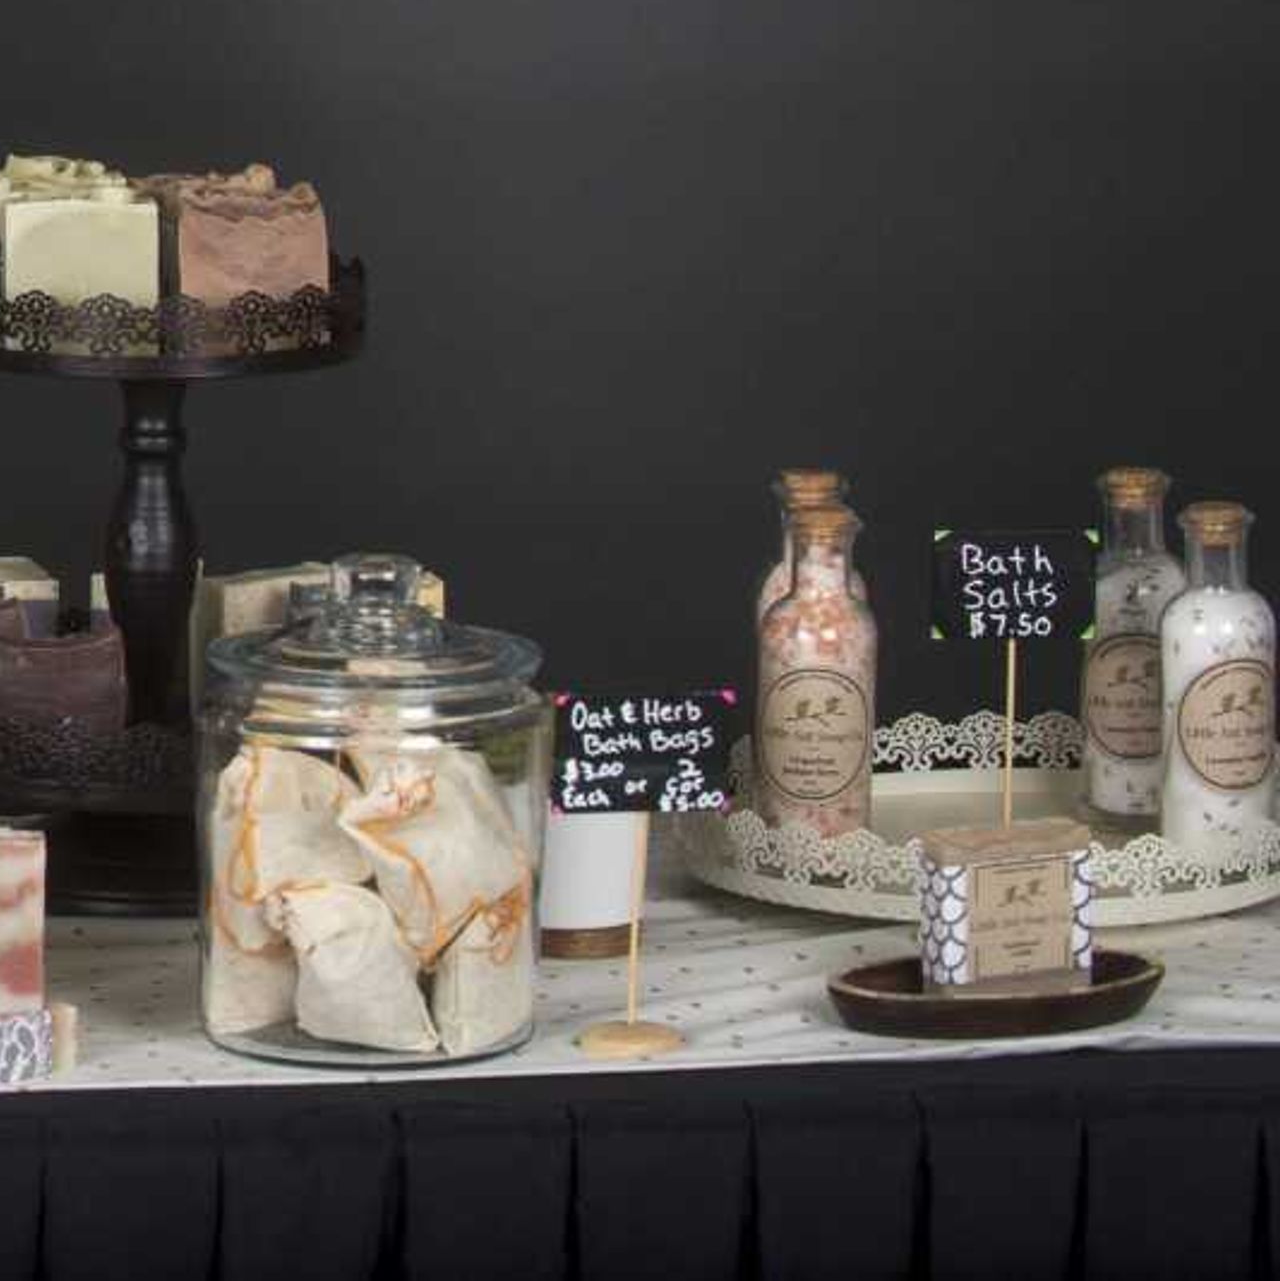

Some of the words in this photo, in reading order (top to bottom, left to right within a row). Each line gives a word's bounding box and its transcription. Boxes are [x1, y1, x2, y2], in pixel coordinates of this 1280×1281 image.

[961, 543, 1054, 575] Bath
[962, 579, 1058, 610] Salts
[570, 701, 615, 730] Oat
[642, 699, 703, 725] Herb
[582, 732, 642, 757] Bath
[649, 726, 716, 754] Bags
[677, 758, 702, 779] 2
[624, 779, 649, 795] or
